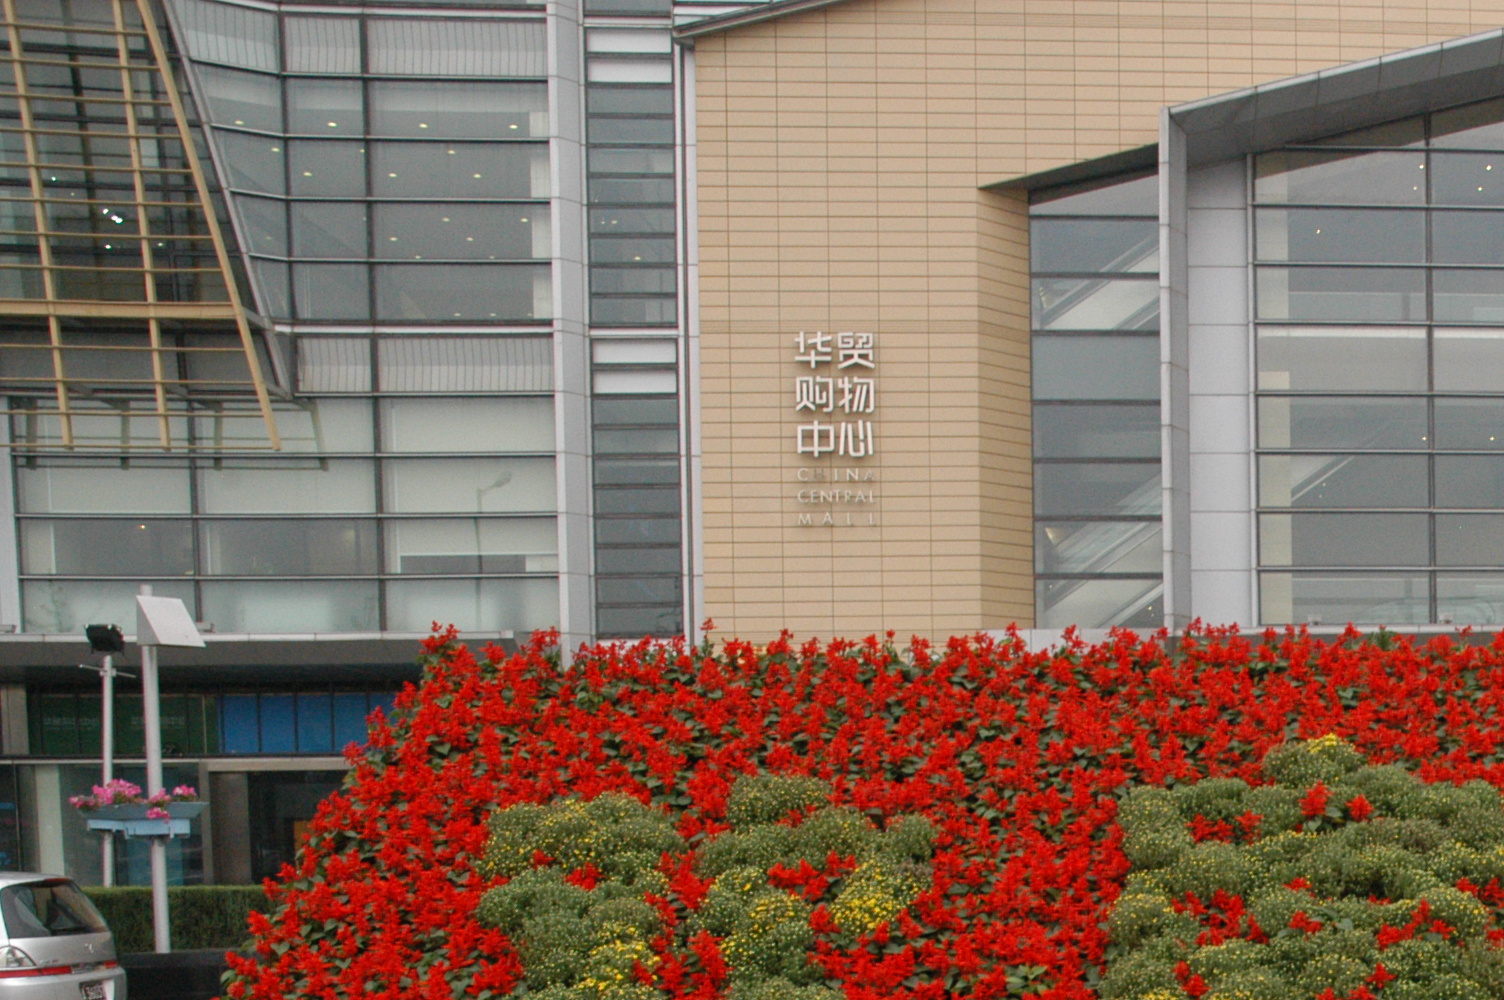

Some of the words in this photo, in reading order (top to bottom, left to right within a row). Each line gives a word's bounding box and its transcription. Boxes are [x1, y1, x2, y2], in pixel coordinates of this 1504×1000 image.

[794, 331, 875, 369] 华贸
[795, 375, 875, 414] 购物
[797, 420, 874, 458] 中心
[797, 467, 875, 482] CHINA
[797, 489, 876, 504] CENTRAL
[797, 512, 876, 526] MALL
